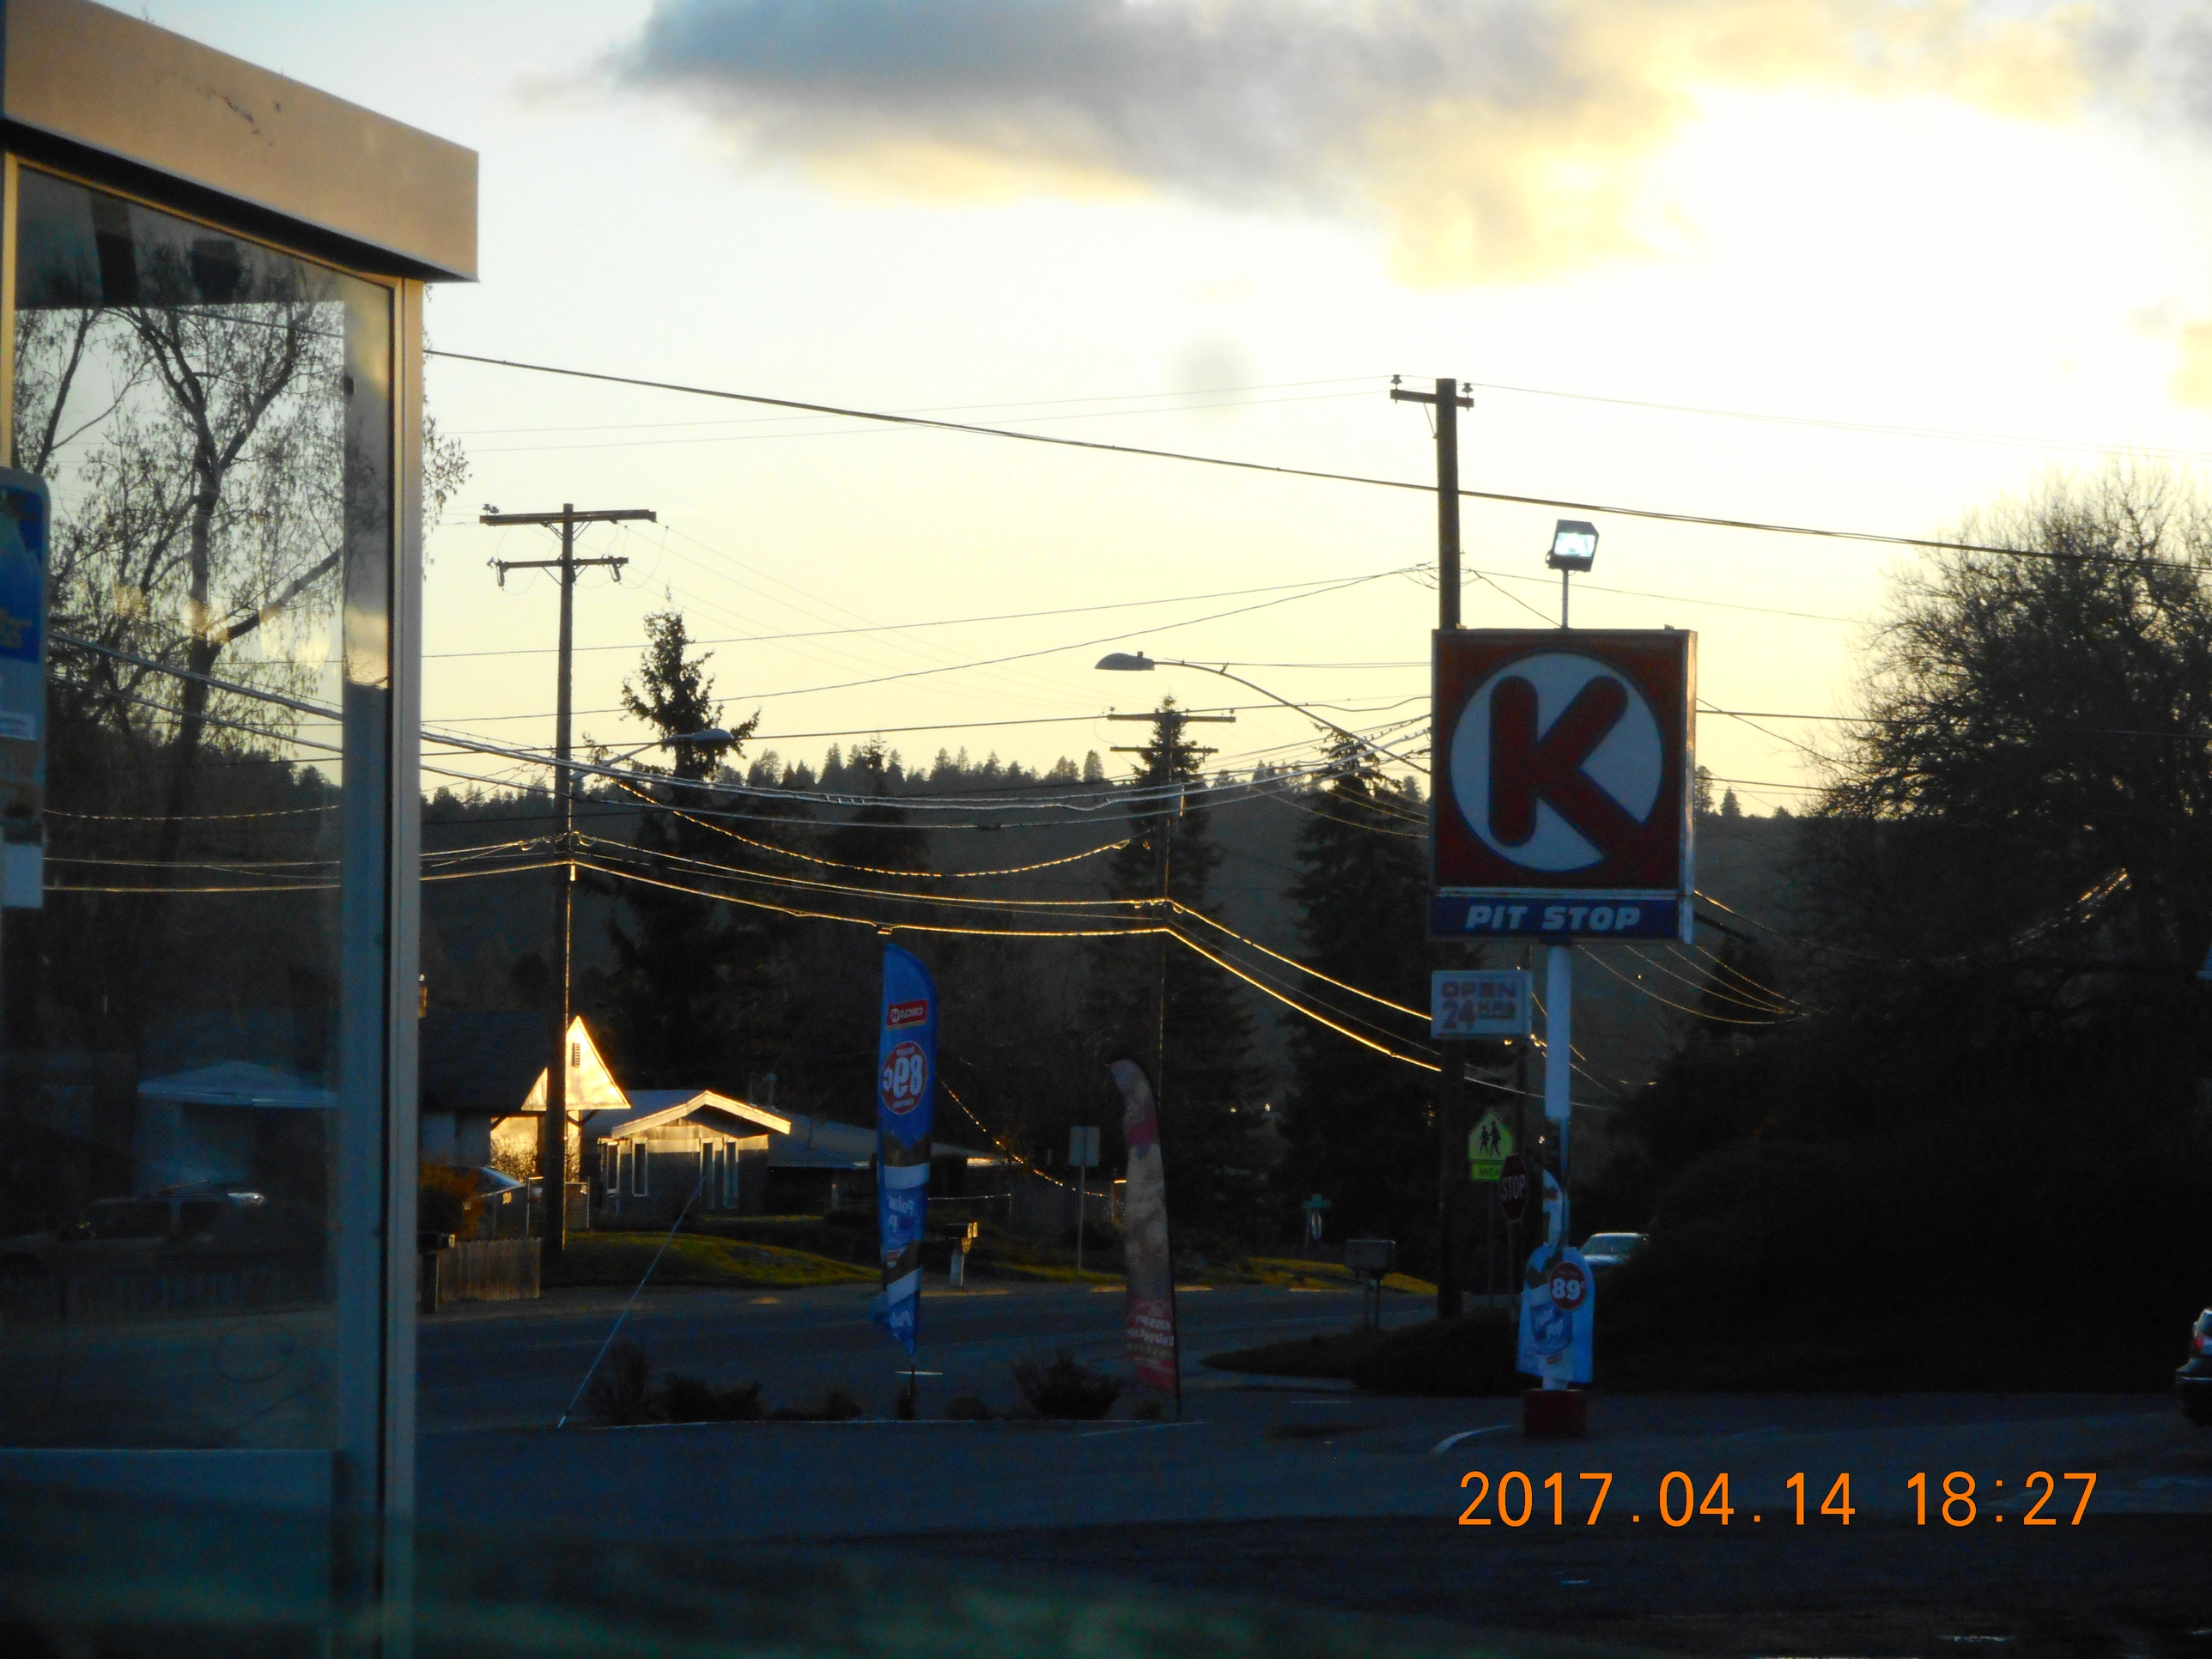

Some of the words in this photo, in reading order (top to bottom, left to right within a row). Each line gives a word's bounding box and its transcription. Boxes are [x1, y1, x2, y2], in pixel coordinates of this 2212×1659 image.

[1488, 675, 1645, 860] K
[1466, 904, 1527, 930] PIT
[1541, 905, 1641, 931] STOP
[1442, 981, 1517, 998] OPEN
[1442, 999, 1476, 1030] 24
[1480, 1167, 1501, 1177] AHEA
[1500, 1174, 1526, 1202] STOP
